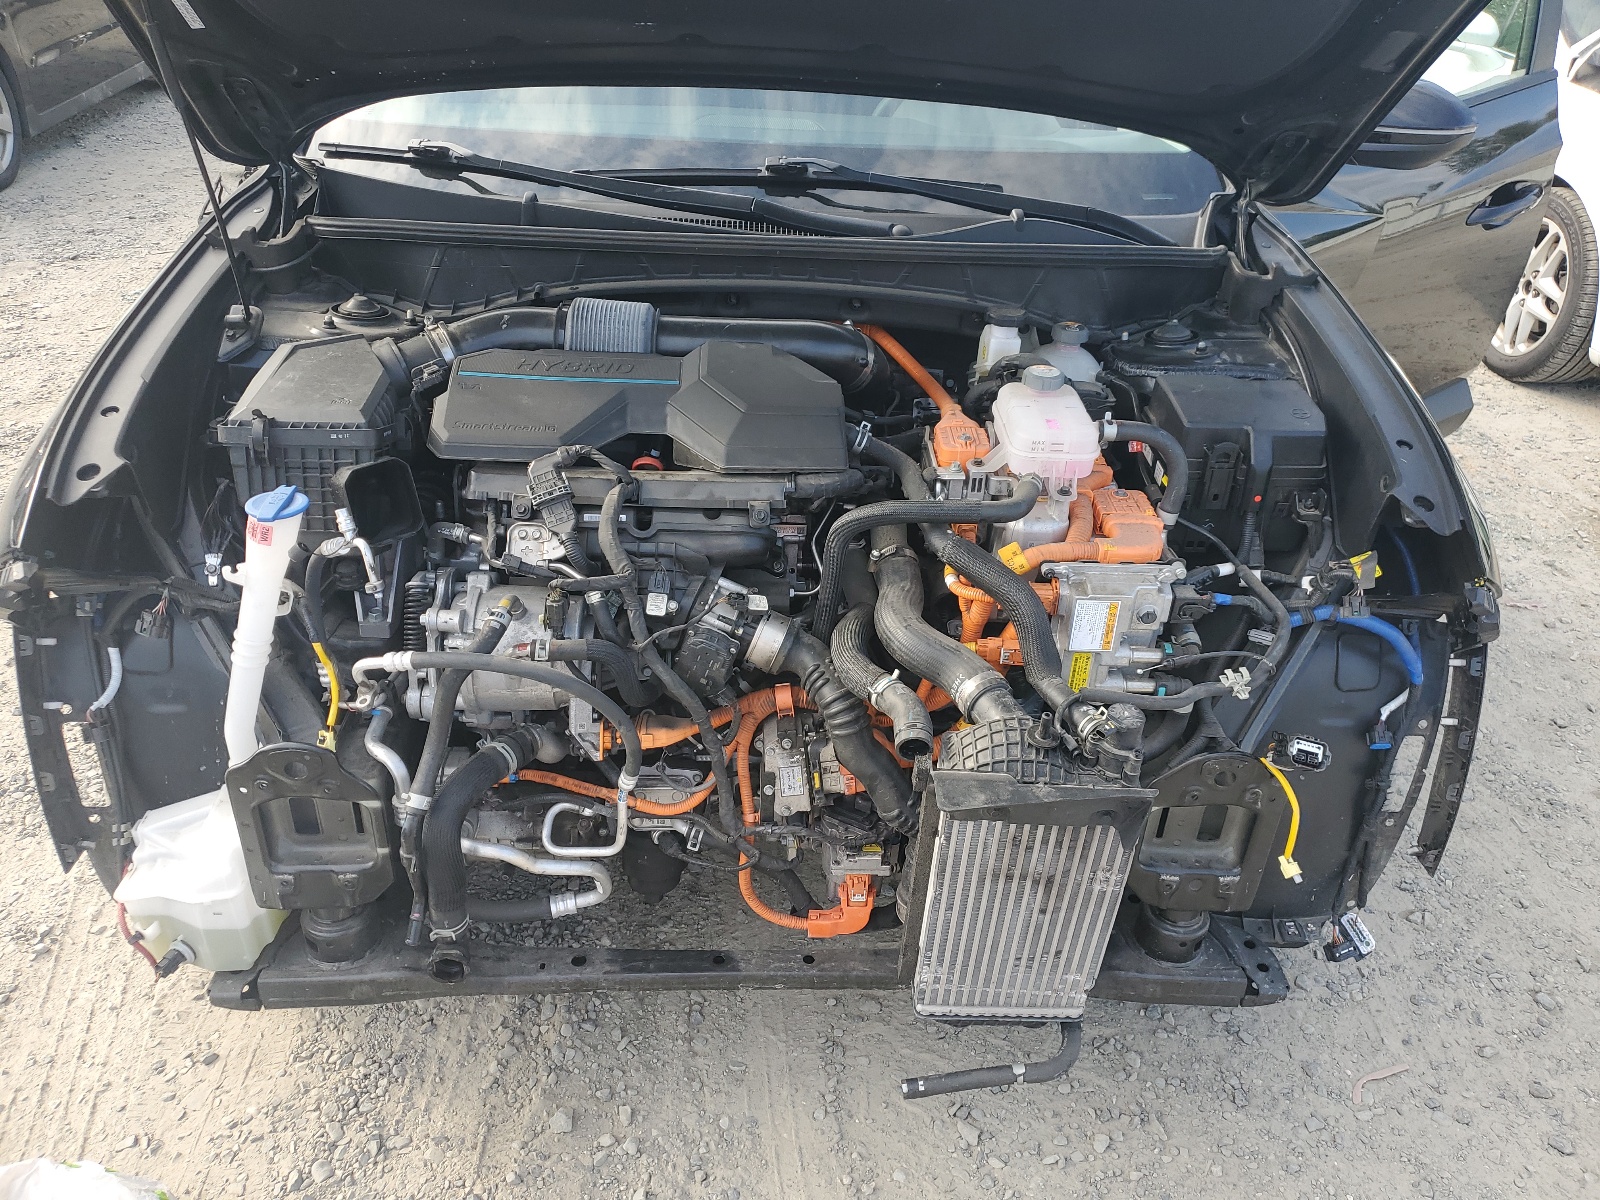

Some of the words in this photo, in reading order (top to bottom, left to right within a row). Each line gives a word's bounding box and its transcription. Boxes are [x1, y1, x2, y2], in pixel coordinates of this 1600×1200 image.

[517, 357, 635, 375] HYBRID
[452, 420, 543, 432] Smartstream
[260, 526, 270, 542] WR2
